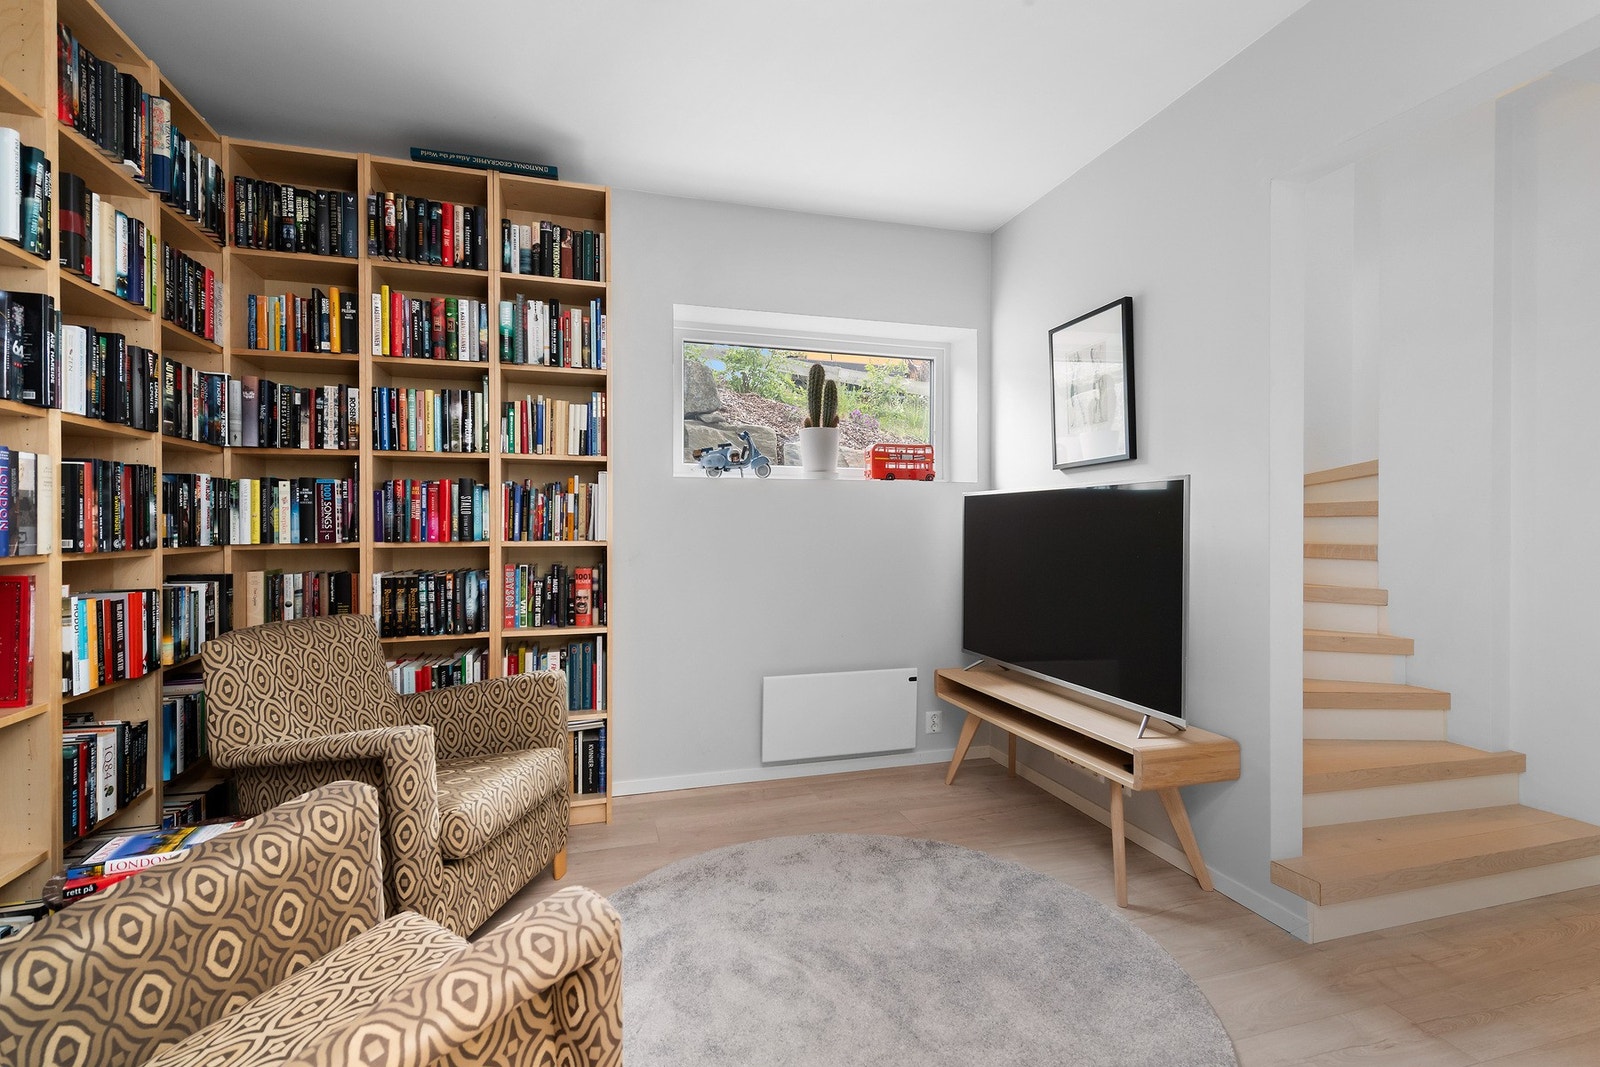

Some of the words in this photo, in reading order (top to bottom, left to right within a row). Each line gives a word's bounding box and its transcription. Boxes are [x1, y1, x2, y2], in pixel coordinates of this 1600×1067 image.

[420, 150, 438, 158] World
[472, 157, 512, 168] GEOGRAPHIC
[512, 162, 544, 172] NATIONAL
[0, 467, 8, 530] LONDON
[460, 496, 471, 514] STALLO
[324, 501, 332, 529] SONGS
[506, 572, 514, 608] BRYSON
[521, 600, 526, 614] VM
[102, 746, 113, 780] 1Q84
[109, 854, 174, 872] LONDON
[66, 888, 82, 897] rett
[83, 885, 94, 896] på
